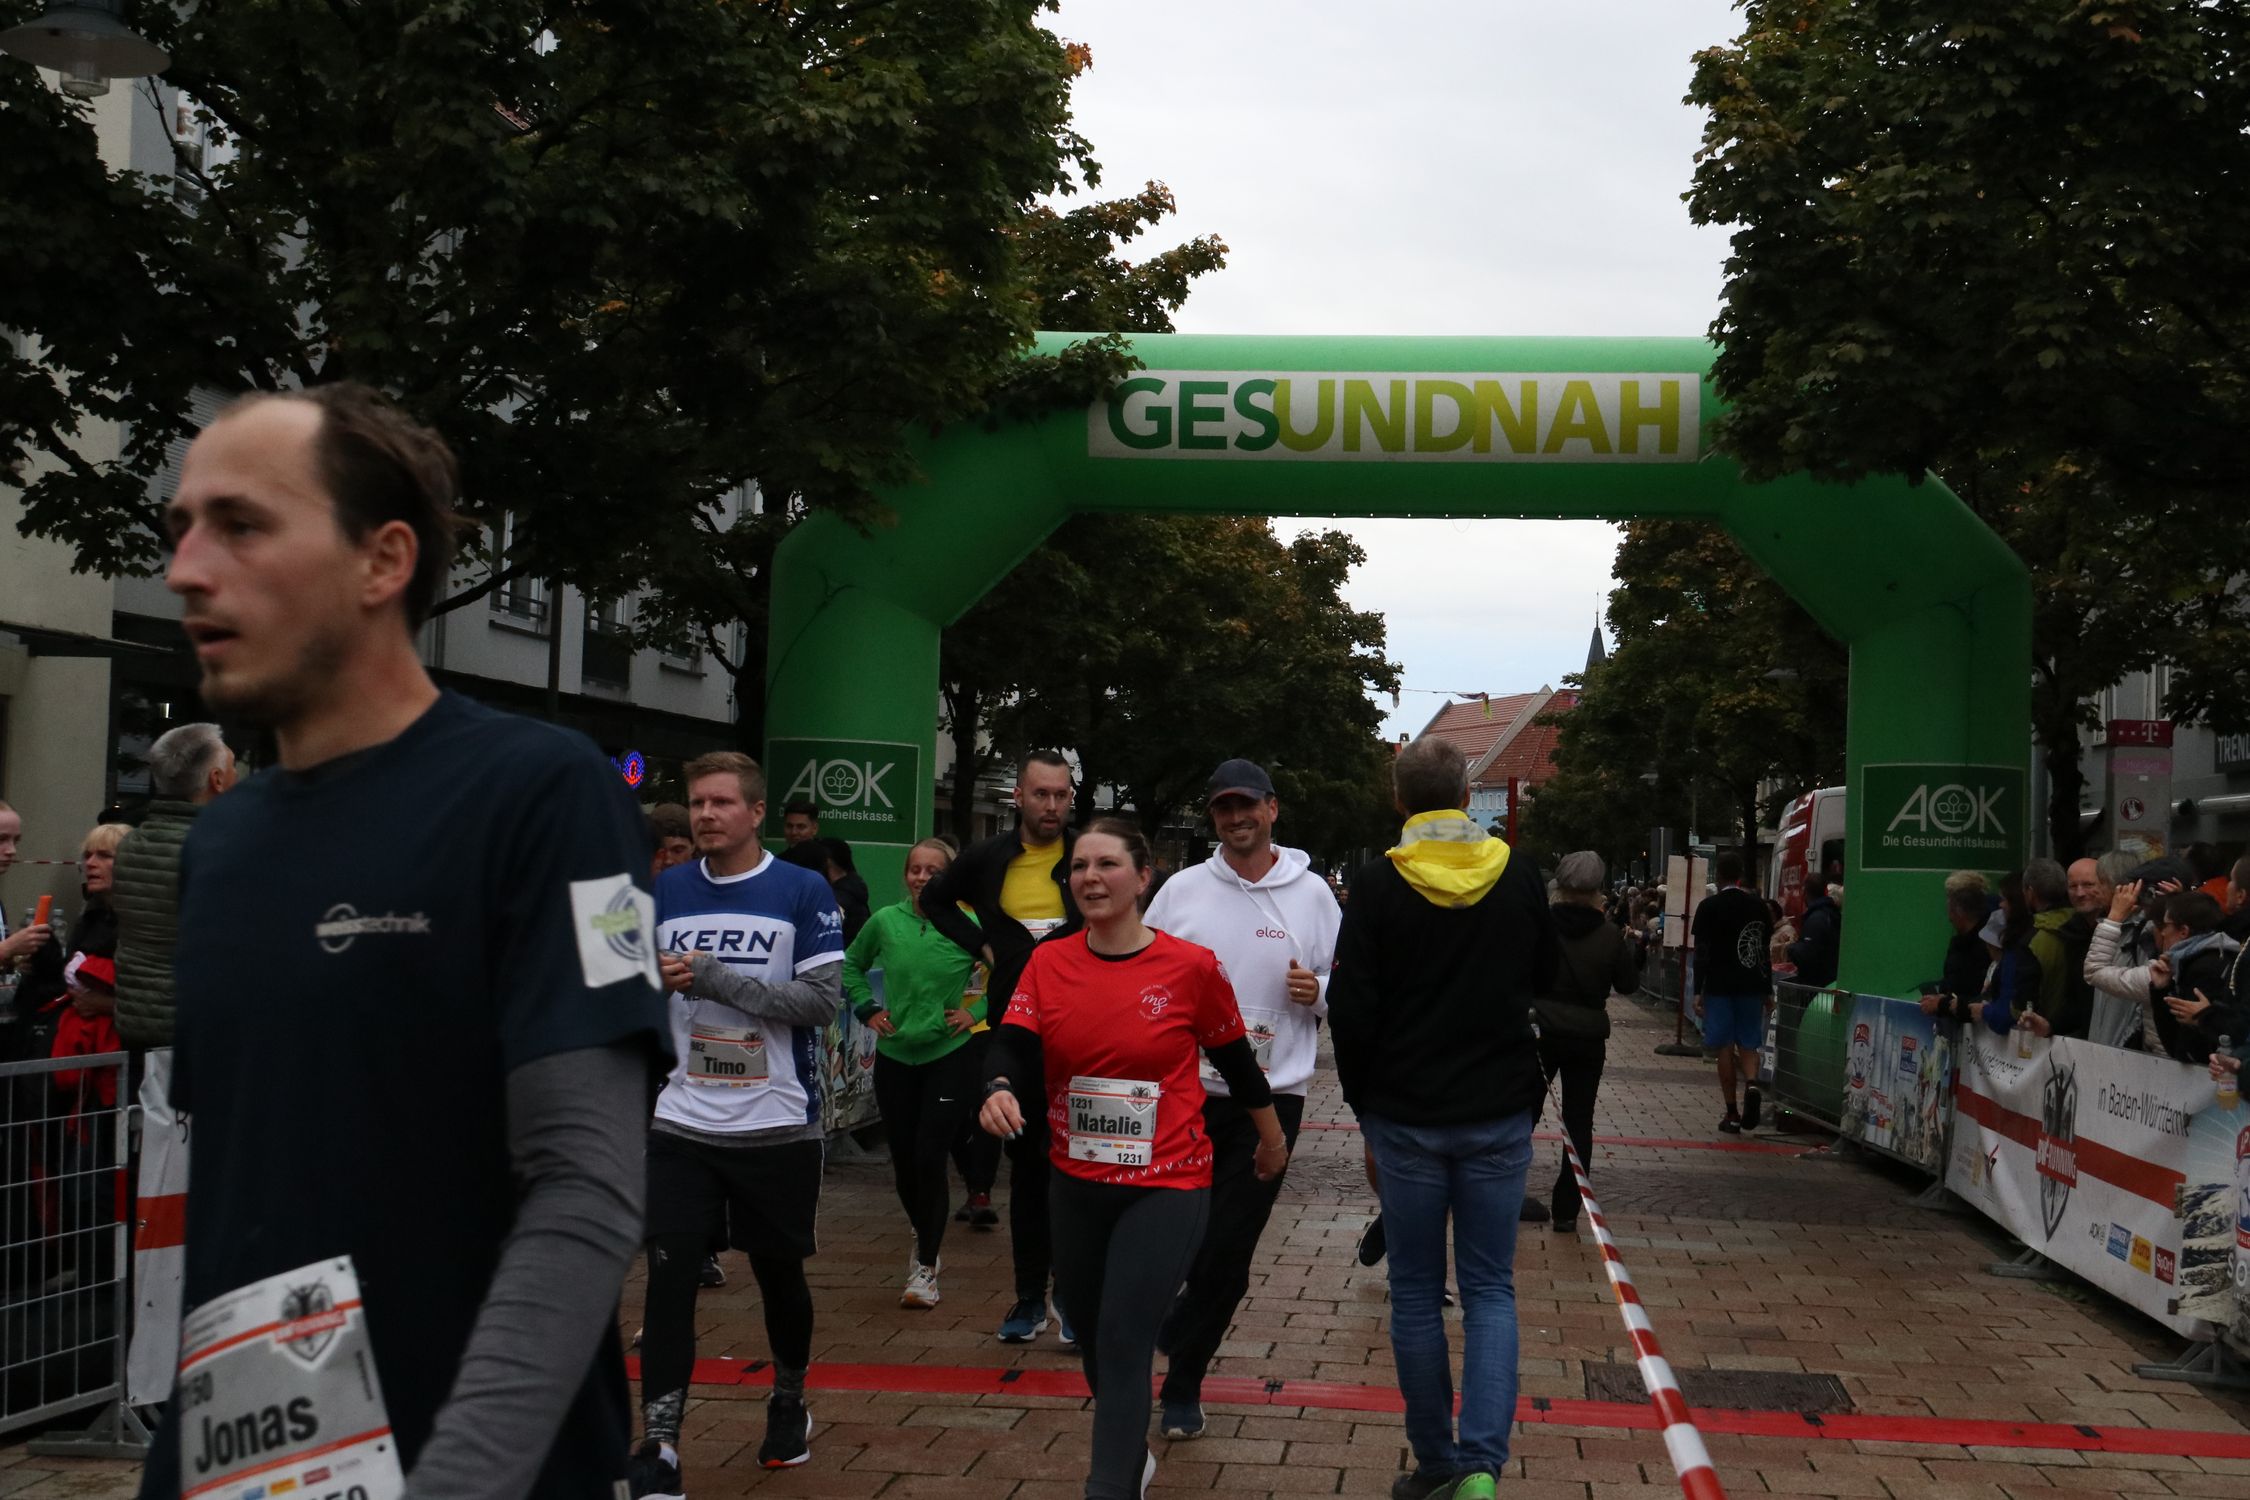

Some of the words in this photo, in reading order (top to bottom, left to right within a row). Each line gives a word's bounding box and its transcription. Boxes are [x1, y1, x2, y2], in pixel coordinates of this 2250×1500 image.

[782, 758, 896, 808] AOK
[1886, 784, 2007, 835] AOK
[1882, 835, 1900, 847] Die
[669, 930, 778, 953] KERN
[1256, 926, 1285, 939] elco
[703, 1056, 746, 1075] Timo
[1070, 1098, 1093, 1109] 1231
[1077, 1113, 1142, 1136] Natalie
[1117, 1152, 1142, 1164] 1231
[195, 1396, 319, 1474] Jonas
